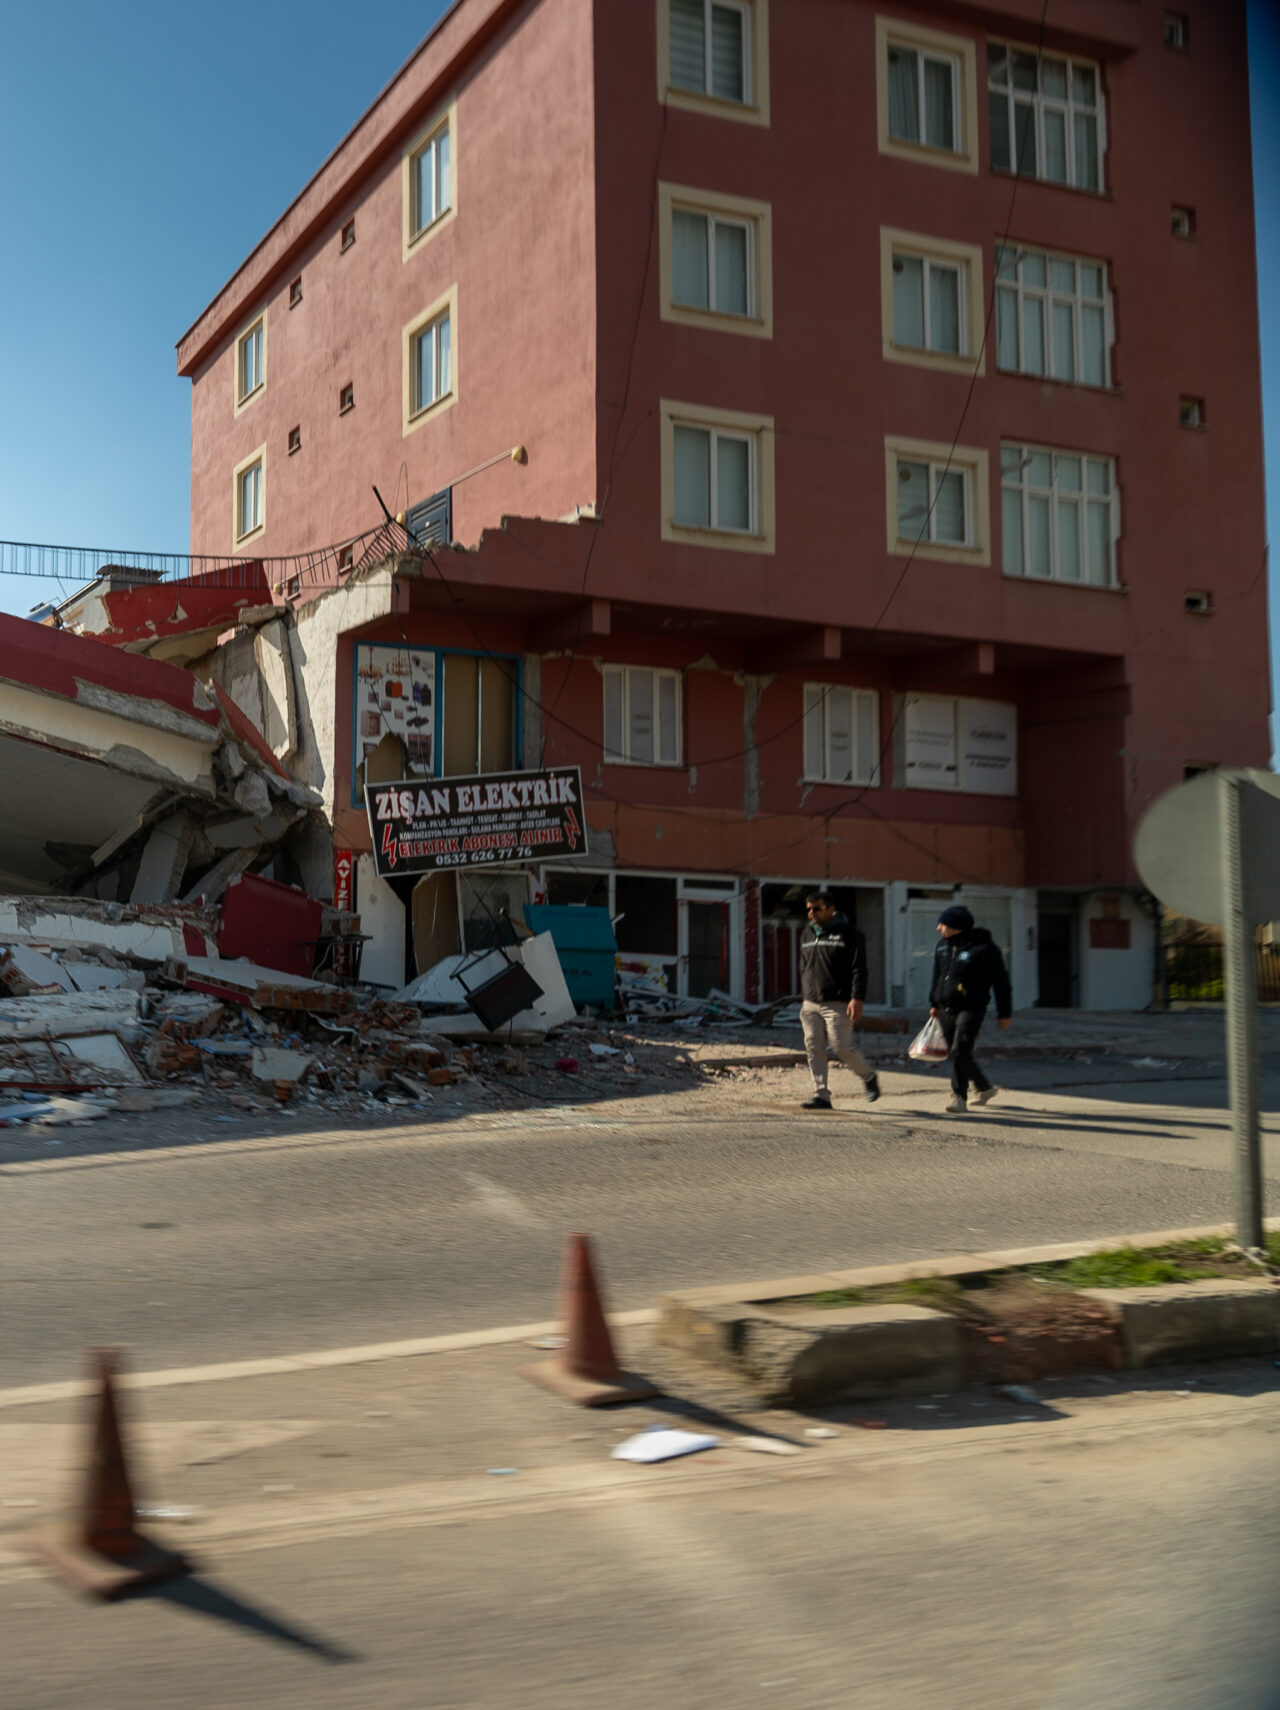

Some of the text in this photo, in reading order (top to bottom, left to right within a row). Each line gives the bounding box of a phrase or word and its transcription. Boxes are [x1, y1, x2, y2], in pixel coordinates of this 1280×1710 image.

[375, 772, 577, 825] ZİŞAN ELEKTRİK
[398, 837, 460, 858] ELEKTRİK
[520, 827, 563, 846] ALINIR
[435, 846, 532, 866] 0532 626 77 76
